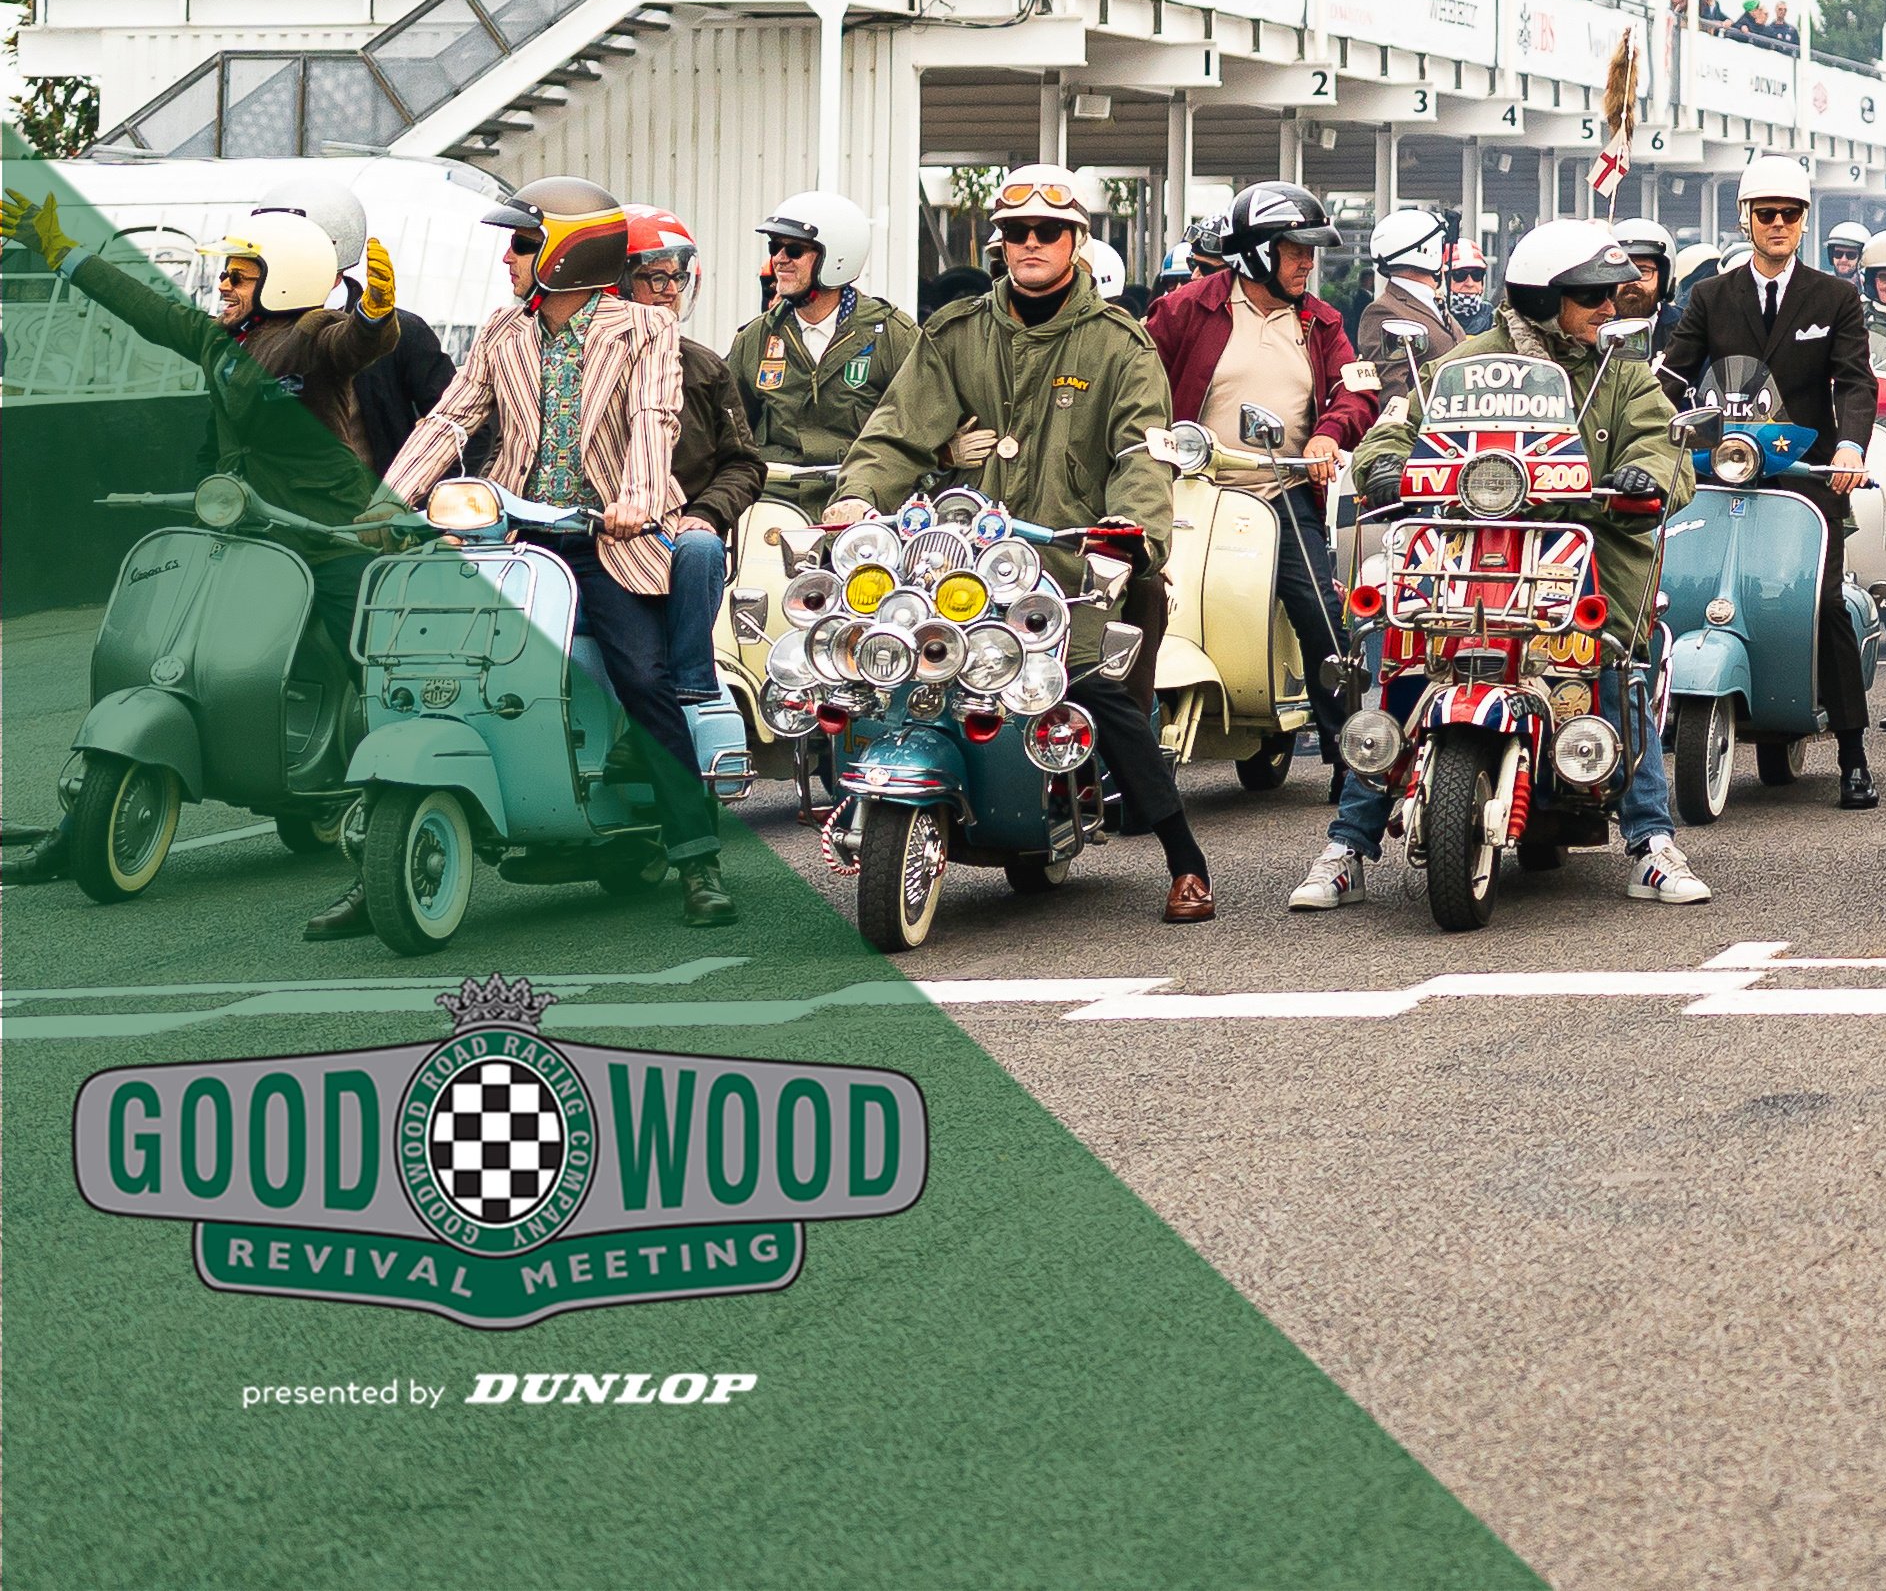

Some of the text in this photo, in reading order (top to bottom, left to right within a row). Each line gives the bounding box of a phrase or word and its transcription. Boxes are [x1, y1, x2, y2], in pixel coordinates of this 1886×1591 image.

[1311, 70, 1329, 96] 2
[1413, 89, 1429, 113] 3
[1501, 104, 1517, 127] 4
[1580, 118, 1594, 139] 5
[1651, 130, 1665, 150] 6
[1849, 165, 1861, 182] 9
[1463, 363, 1533, 391] ROY
[1406, 464, 1589, 493] TV 200
